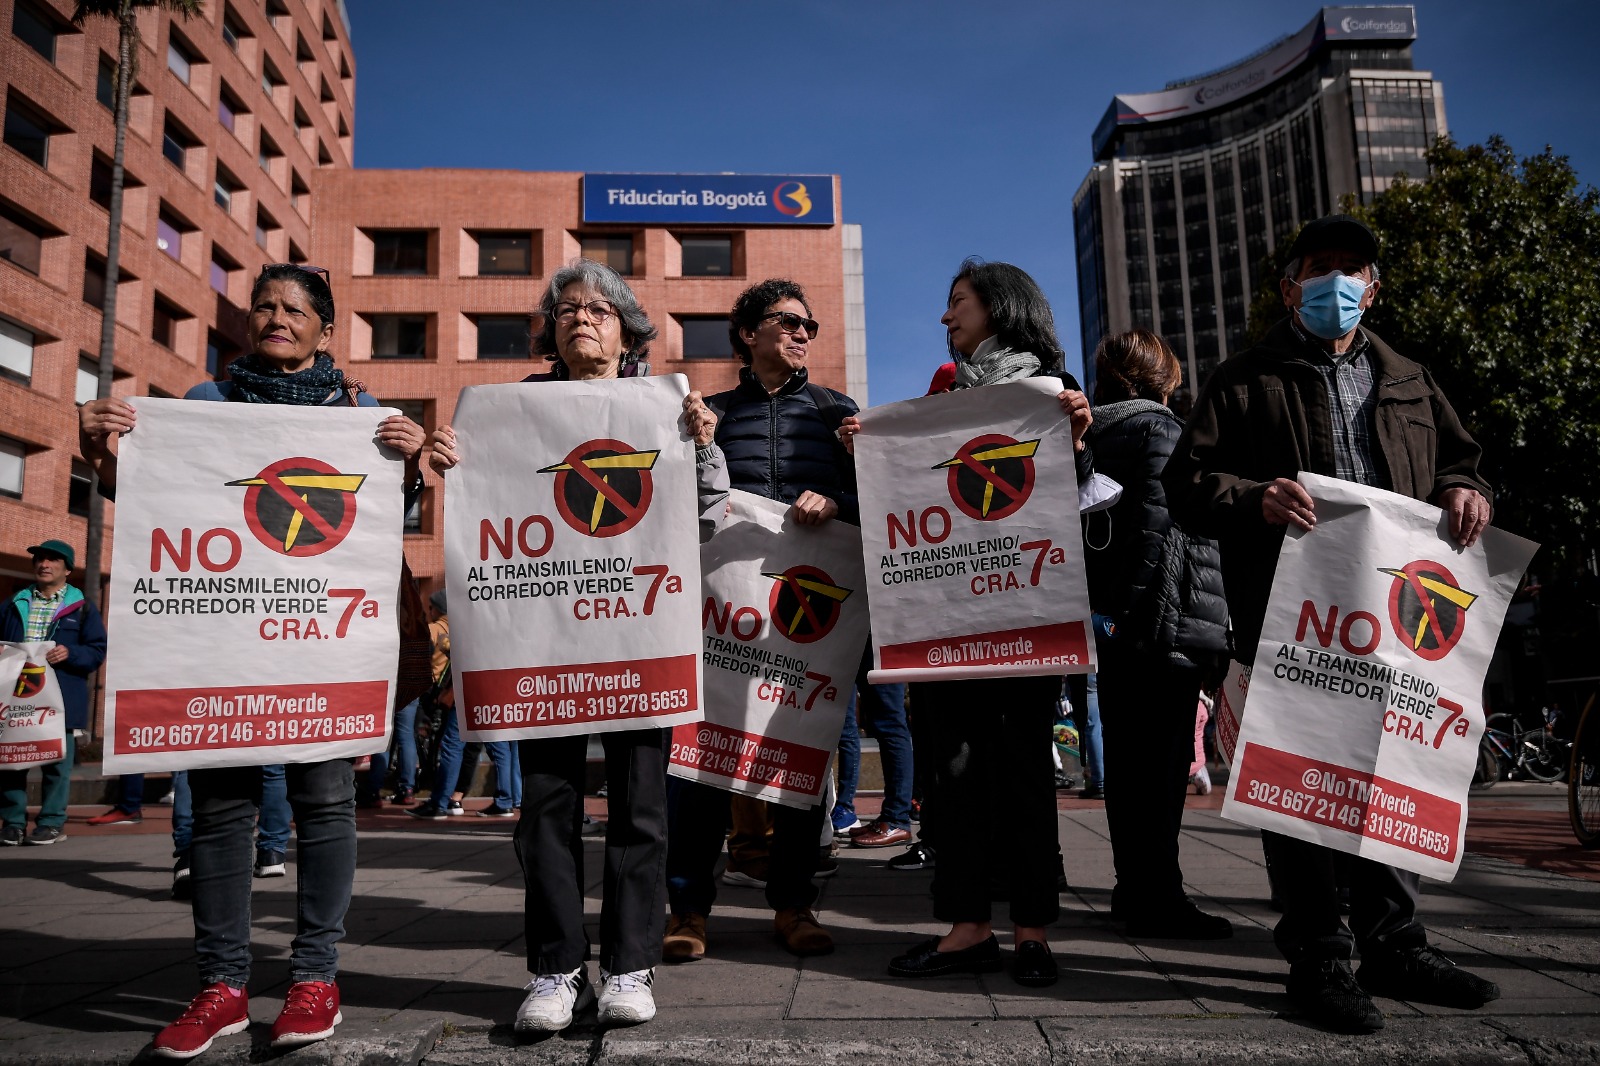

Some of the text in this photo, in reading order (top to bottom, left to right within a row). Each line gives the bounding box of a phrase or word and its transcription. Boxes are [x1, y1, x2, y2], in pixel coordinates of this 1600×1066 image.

[607, 188, 767, 210] Fiduciaria Bogotá
[479, 514, 554, 562] NO
[886, 505, 952, 550] NO
[150, 528, 242, 572] NO
[880, 535, 1020, 569] AL TRANSMILENIO/
[467, 557, 633, 582] AL TRANSMILENIO/
[882, 552, 1022, 585] CORREDOR VERDE
[970, 571, 1026, 595] CRA.
[133, 577, 329, 594] AL TRANSMILENIO/
[468, 576, 635, 602] CORREDOR VERDE
[133, 598, 328, 615] CORREDOR VERDE
[573, 597, 638, 621] CRA.
[702, 596, 763, 642] NO
[259, 618, 329, 641] CRA.
[1294, 600, 1382, 656] NO
[706, 635, 809, 674] TRANSMILENIO/
[927, 636, 1033, 665] @NoTM7verde
[516, 669, 641, 698] @NoTM7verde
[702, 651, 805, 689] RREDOR VERDE
[1277, 643, 1440, 700] AL TRANSMILENIO/
[186, 692, 327, 718] @NoTM7verde
[757, 683, 801, 709] CRA.
[1273, 663, 1385, 703] CORREDOR
[1389, 689, 1436, 720] VERDE
[1382, 710, 1429, 746] CRA.
[0, 744, 38, 753] TM7verde
[696, 729, 788, 764] @NoTM7verde
[1301, 768, 1416, 818] @NoTM7verde
